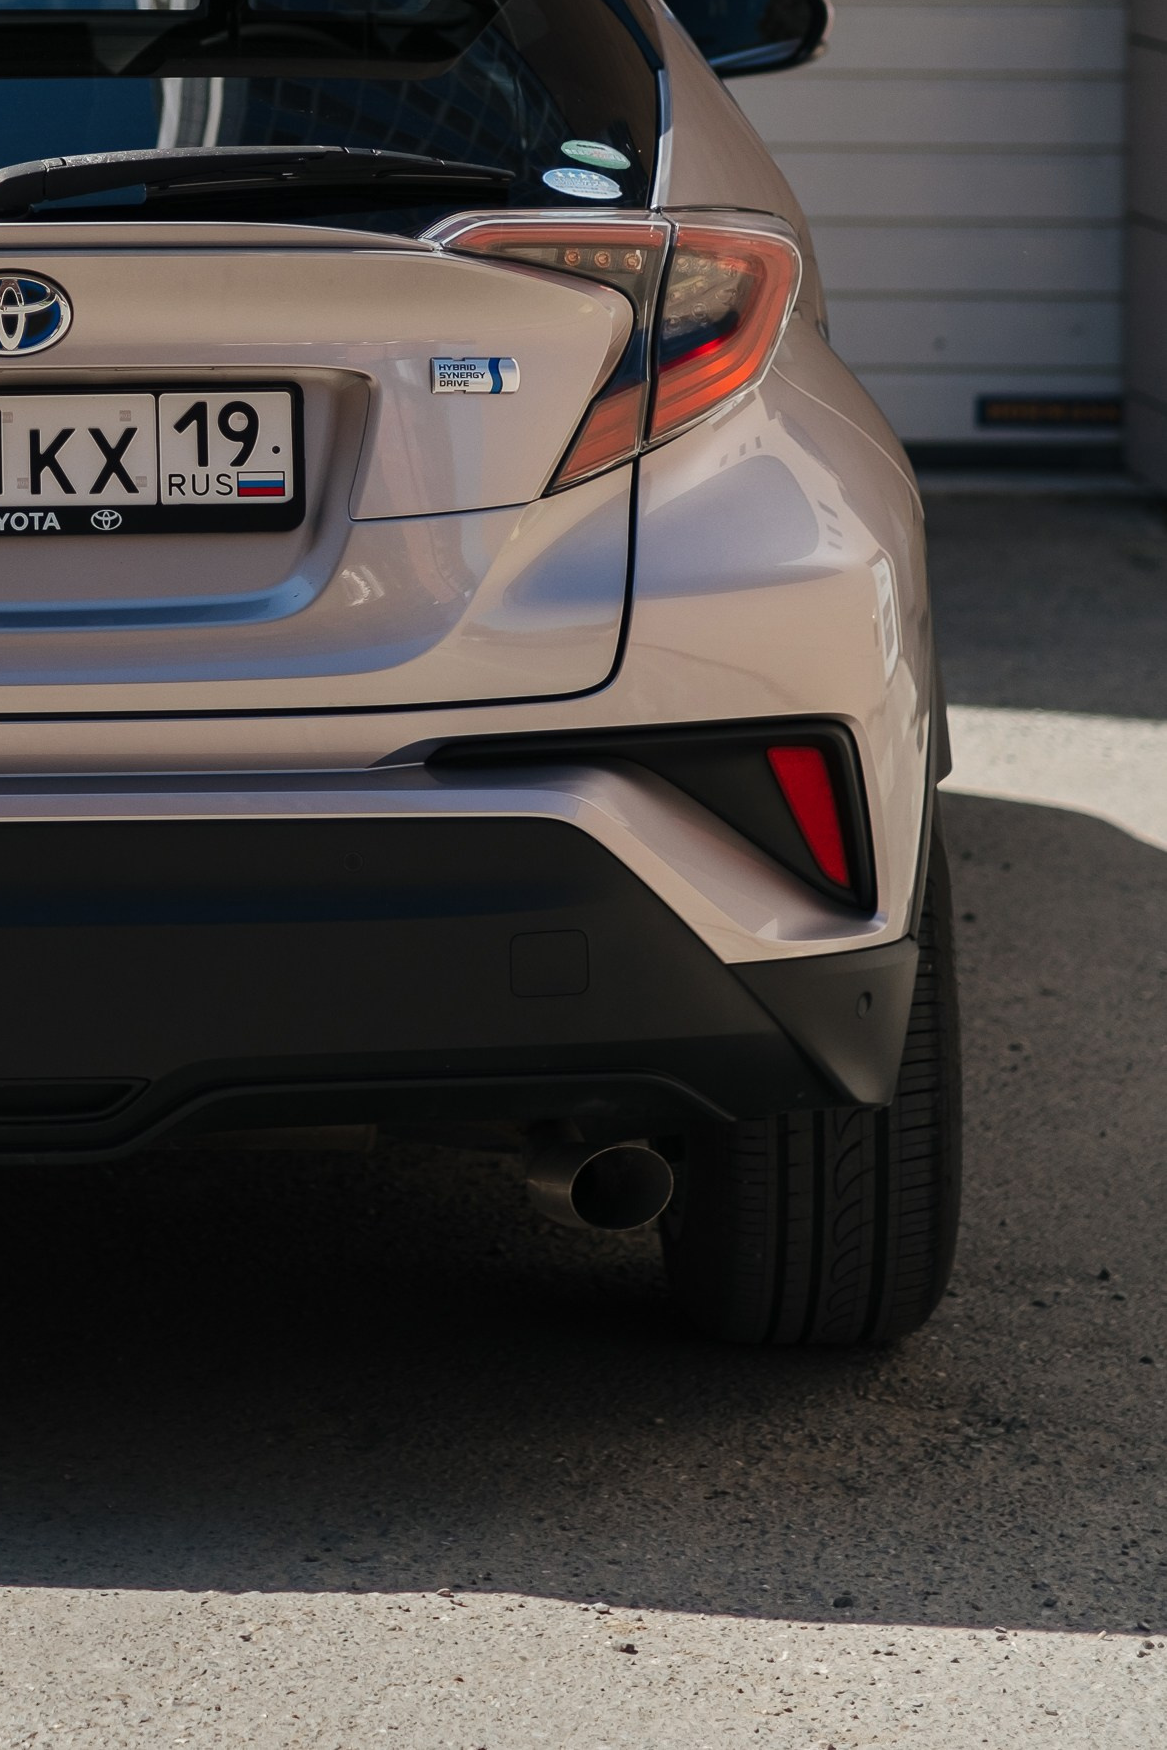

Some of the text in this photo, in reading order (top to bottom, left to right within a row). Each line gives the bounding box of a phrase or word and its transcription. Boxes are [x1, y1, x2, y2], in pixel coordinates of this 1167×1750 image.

[438, 363, 476, 371] HYBRID
[439, 371, 485, 379] SYNERGY
[439, 379, 470, 387] DRIVE
[173, 400, 259, 468] 19
[167, 473, 234, 497] RUS
